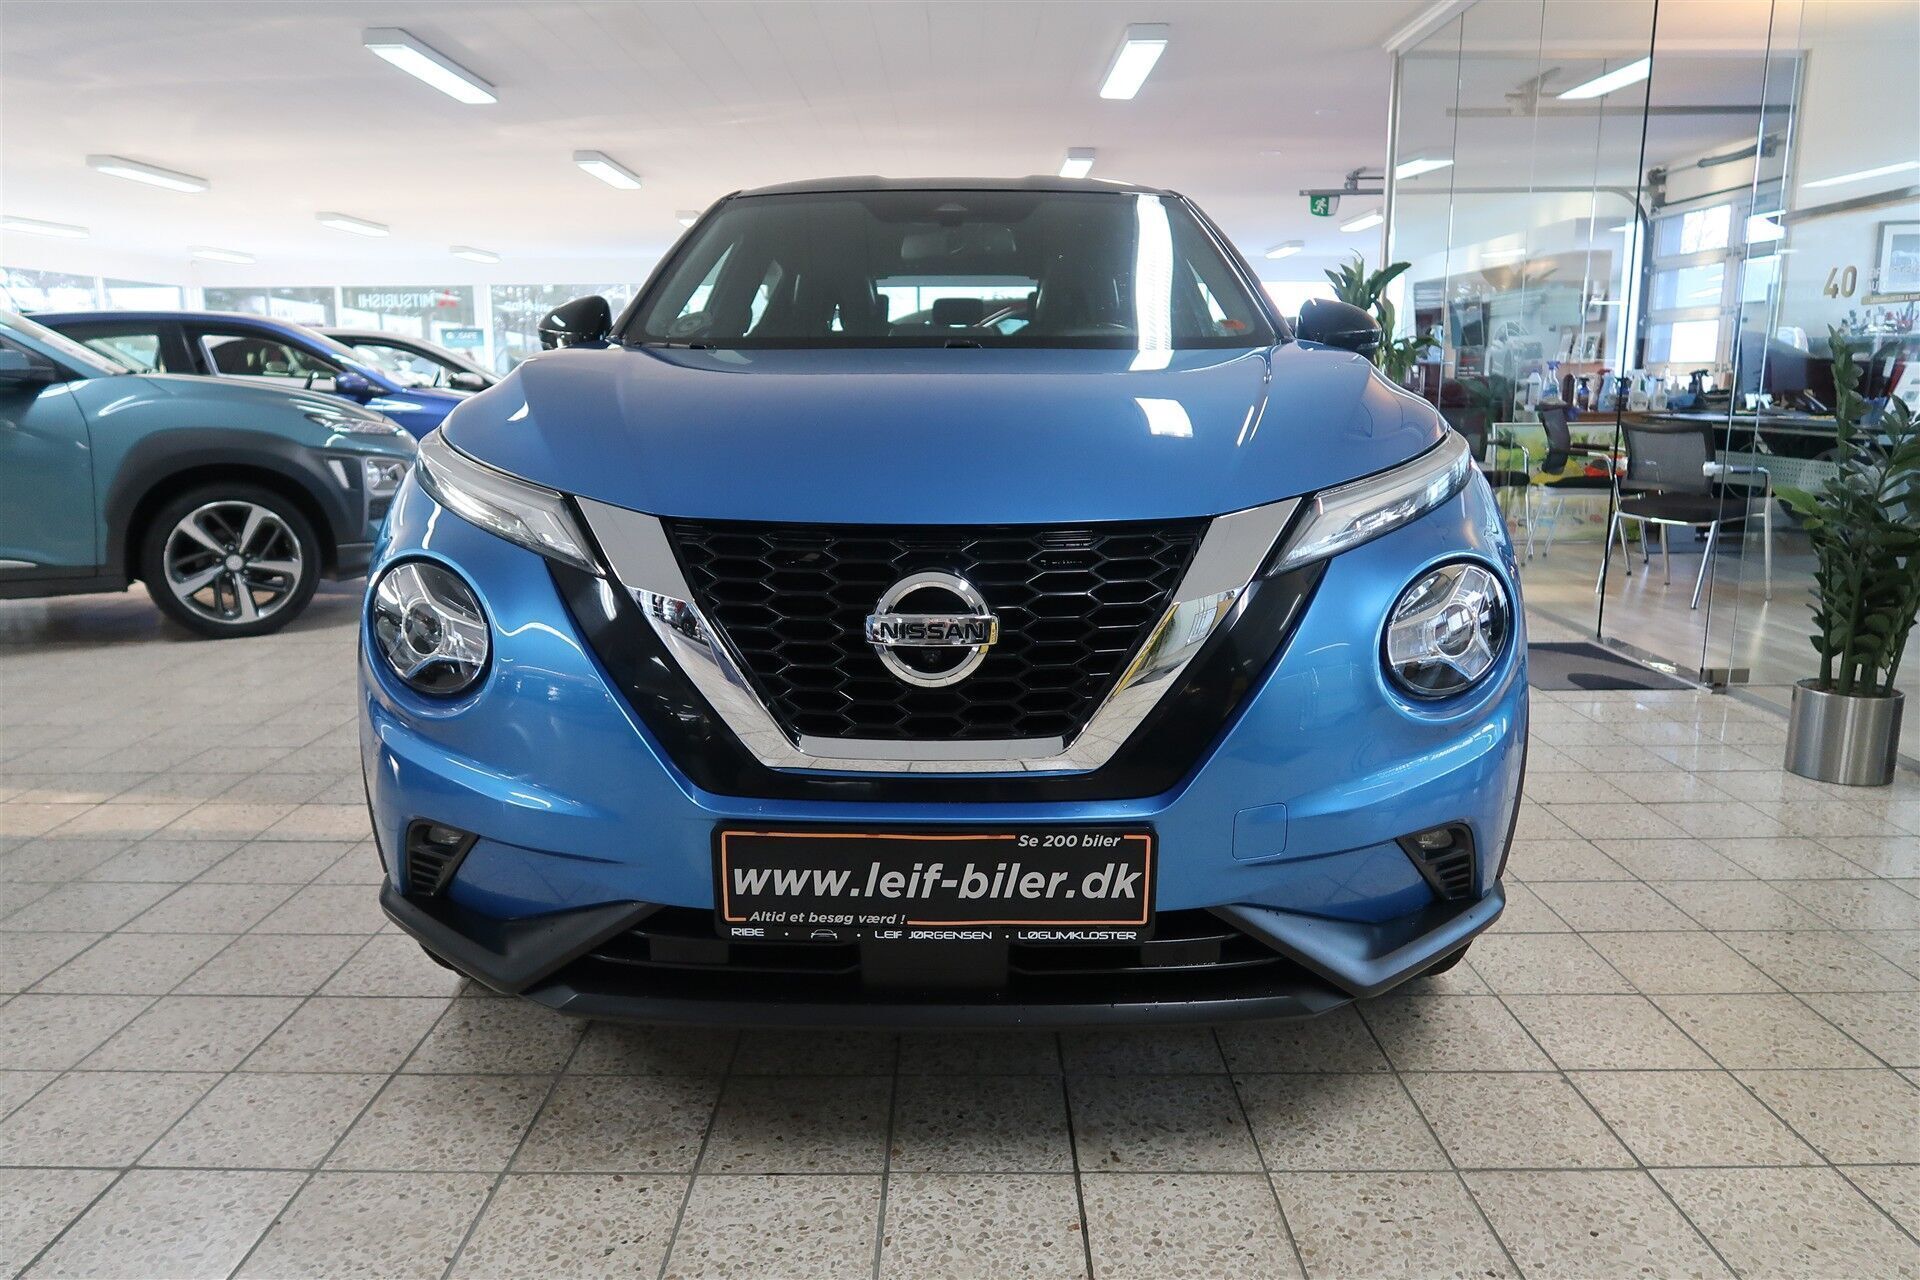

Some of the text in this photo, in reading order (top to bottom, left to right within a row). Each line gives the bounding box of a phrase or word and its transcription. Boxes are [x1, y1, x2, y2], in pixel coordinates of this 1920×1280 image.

[1823, 265, 1857, 299] 40
[880, 622, 984, 640] NISSAN
[1018, 834, 1120, 848] Se 200 biler
[734, 861, 1142, 899] www.leif-biler.dk
[749, 911, 786, 922] Altid
[789, 913, 804, 922] et
[808, 912, 853, 925] besøg
[858, 914, 896, 925] værd
[731, 927, 764, 936] RIBE
[874, 930, 992, 940] LEIF JØRGENSEN
[1018, 931, 1137, 940] LØGUMKLOSTER
